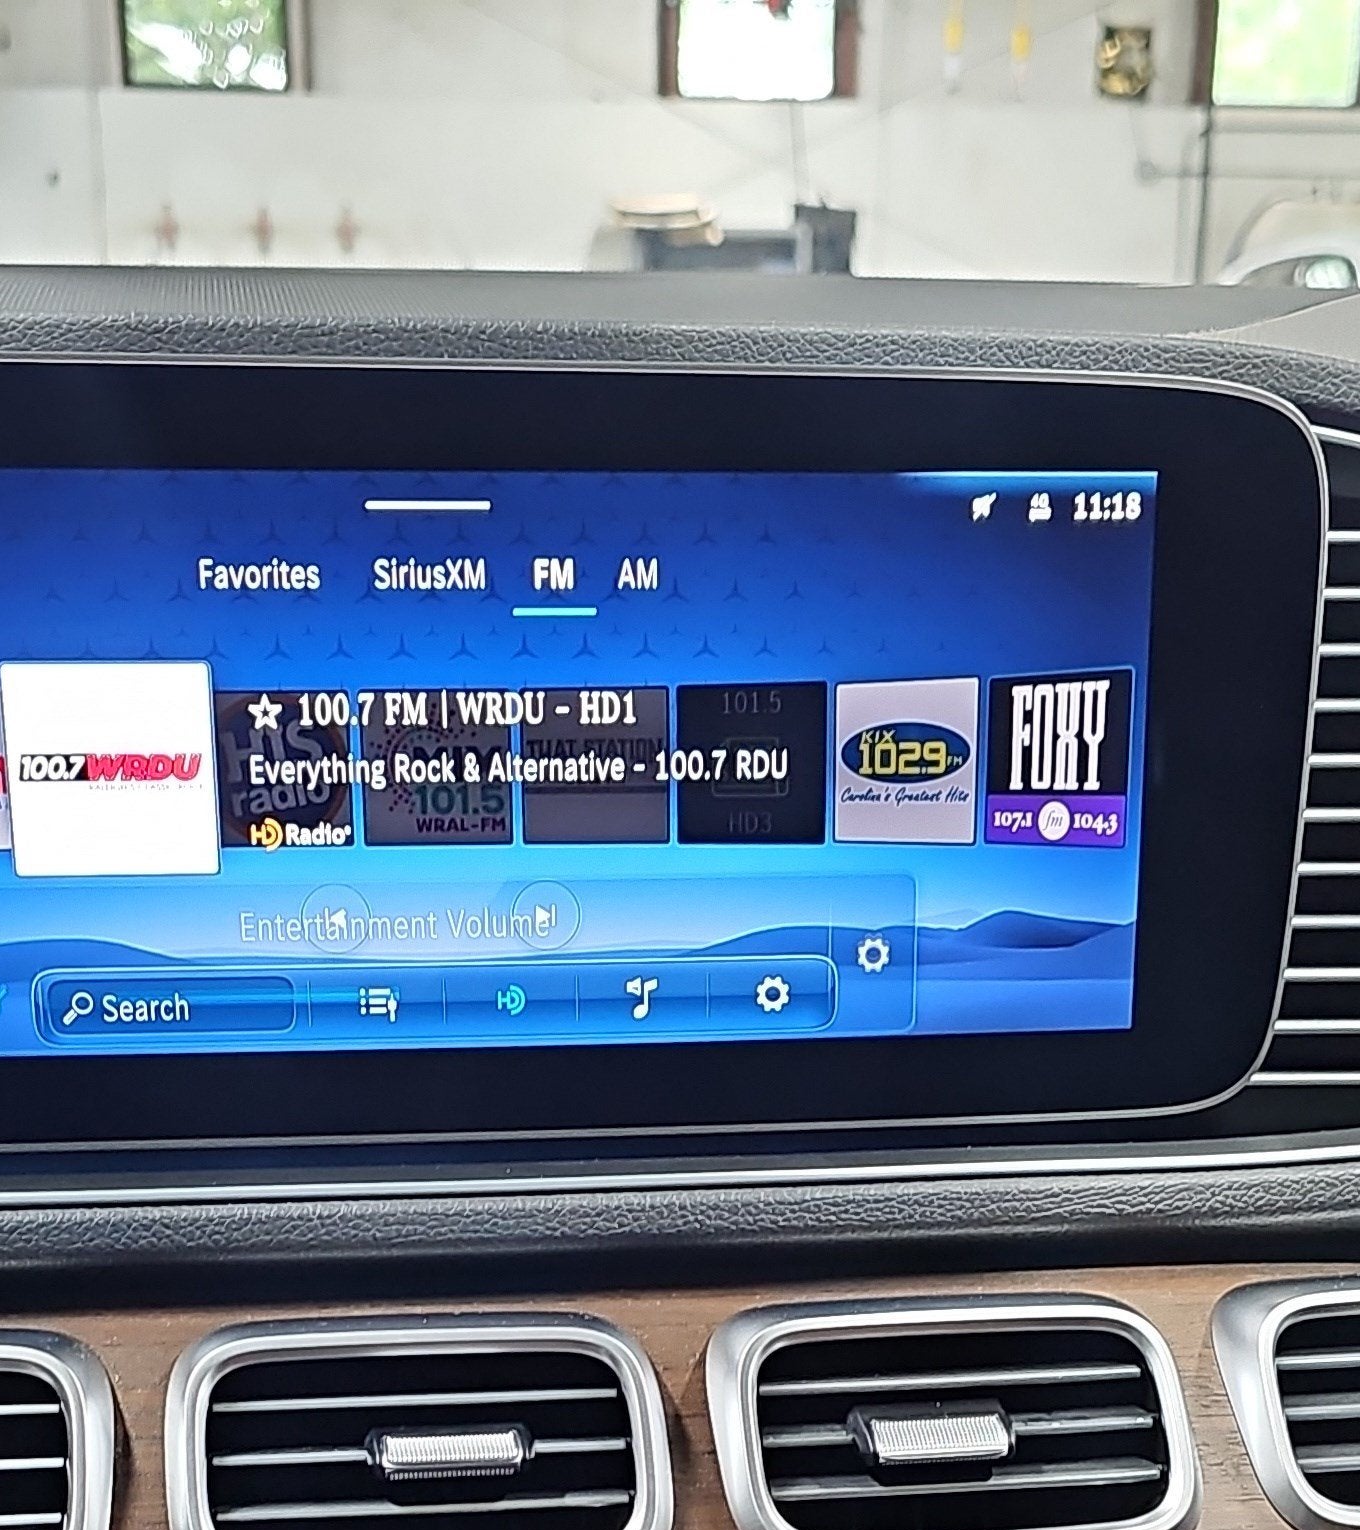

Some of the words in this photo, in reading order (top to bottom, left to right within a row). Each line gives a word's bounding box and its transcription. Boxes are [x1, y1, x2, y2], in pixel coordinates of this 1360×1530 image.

[1073, 491, 1142, 521] 11:18
[198, 557, 321, 591] Favorites
[373, 557, 486, 591] SiriusXM
[533, 557, 575, 590] FM
[617, 557, 658, 590] AM
[298, 691, 375, 726] 100.7
[384, 692, 428, 726] FM
[455, 691, 546, 726] WRDU
[578, 690, 637, 724] HD1
[722, 690, 782, 714] 101.5
[860, 729, 896, 745] KIX
[1009, 680, 1111, 791] FOXY
[20, 754, 87, 781] 100.7
[88, 753, 202, 781] WRDU
[249, 752, 387, 791] Everything
[394, 752, 456, 783] Rock
[463, 753, 481, 783] &
[487, 750, 626, 784] Alternative
[654, 749, 727, 782] 100.7
[736, 748, 789, 781] RDU
[858, 741, 947, 775] 102.9
[414, 784, 506, 815] 101.5
[895, 785, 942, 807] Greatest
[286, 820, 346, 847] Radio
[416, 817, 507, 833] WRAL-FM
[728, 811, 772, 834] HD3
[240, 908, 438, 942] Entertainment
[446, 907, 551, 940] Volume
[102, 993, 190, 1023] Search
